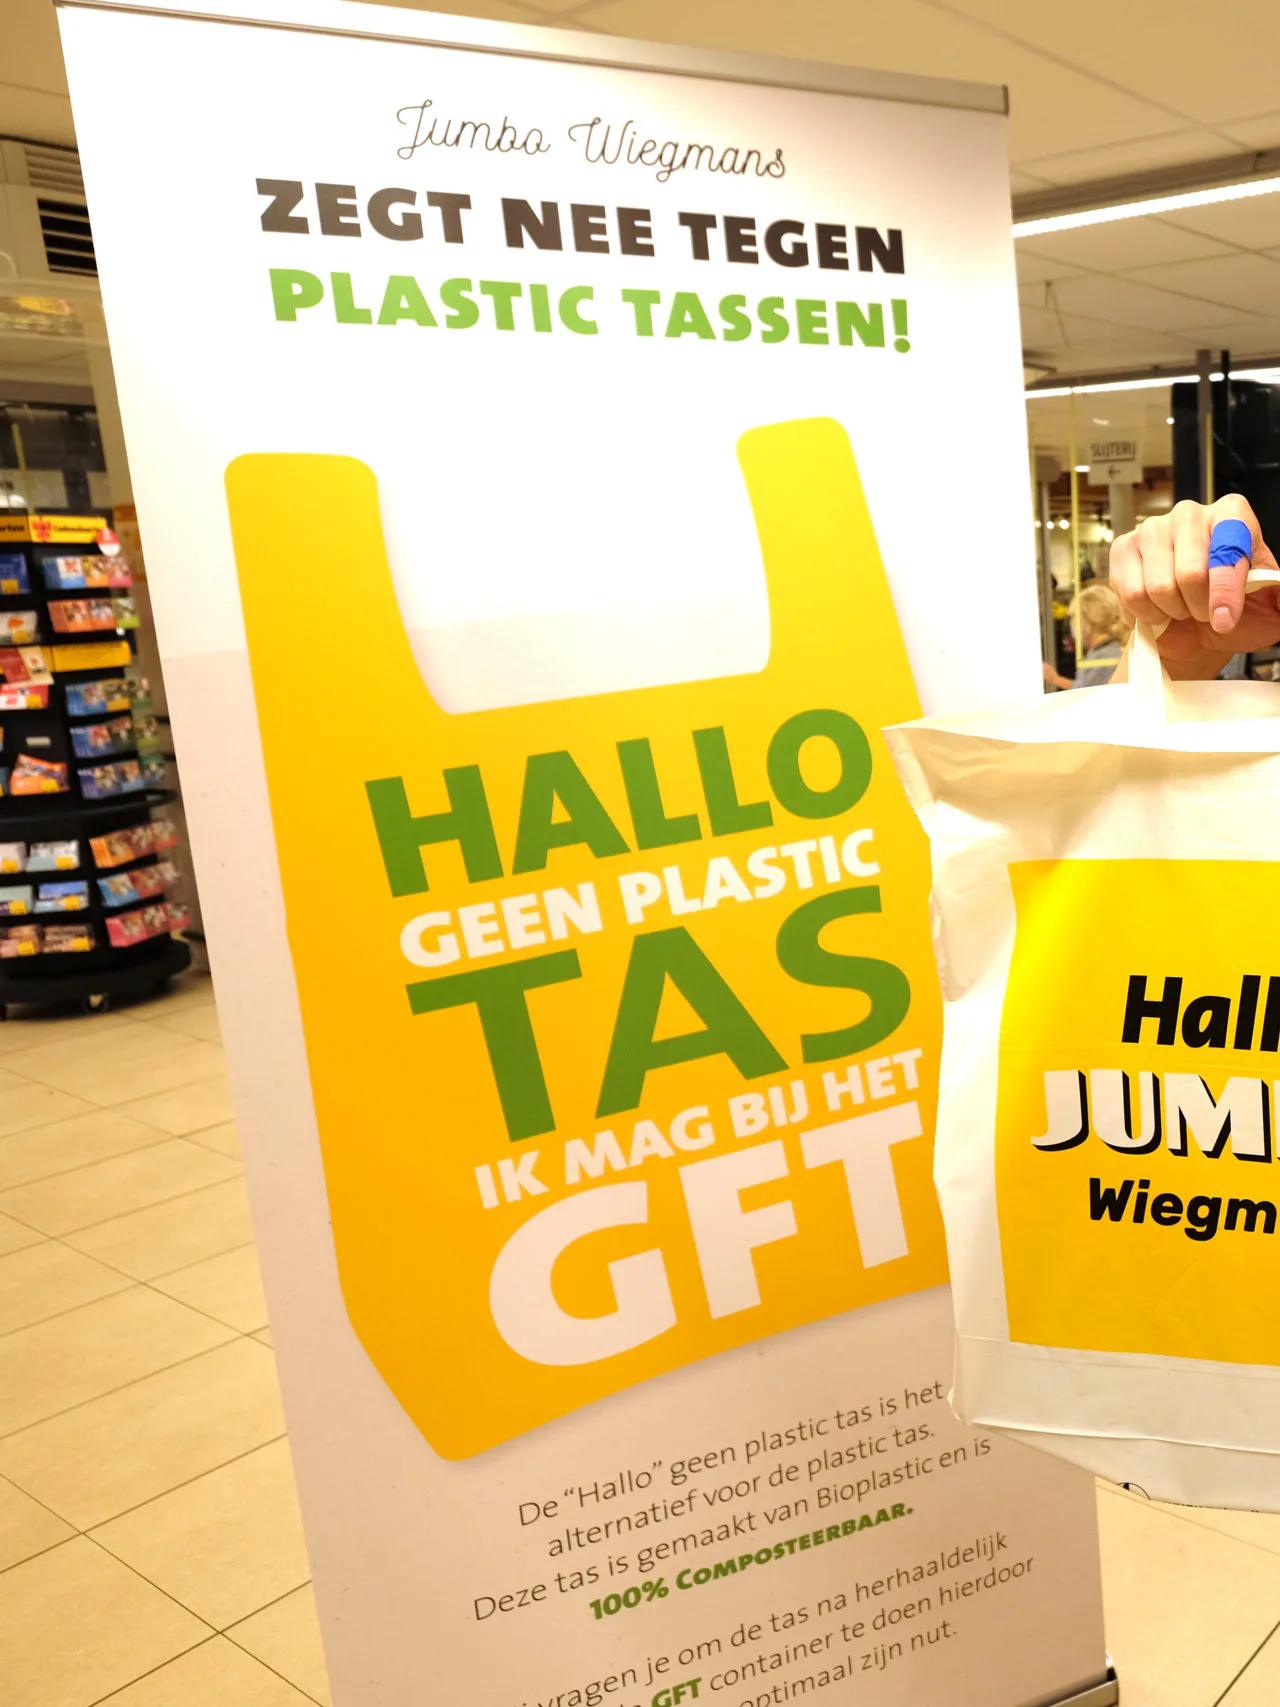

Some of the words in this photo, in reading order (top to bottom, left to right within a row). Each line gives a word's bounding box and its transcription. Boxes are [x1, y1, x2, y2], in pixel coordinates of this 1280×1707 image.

[396, 99, 551, 160] Jumbo
[568, 116, 788, 183] Wiegmans
[255, 178, 472, 244] ZEGT
[501, 197, 656, 257] NEE
[678, 211, 906, 275] TEGEN
[268, 268, 599, 336] PLASTIC
[621, 288, 911, 354] TASSEN!
[365, 708, 873, 898] HALLO
[400, 882, 604, 968] GEEN
[617, 828, 881, 925] PLASTIC
[406, 885, 912, 1143] TAS
[474, 1149, 550, 1210] IK
[564, 1105, 715, 1185] MAG
[728, 1080, 808, 1139] BIJ
[823, 1048, 924, 1112] HET
[488, 1100, 924, 1367] GFT
[518, 1498, 559, 1527] De
[669, 1445, 736, 1486] geen
[744, 1417, 829, 1464] plastic
[833, 1404, 873, 1430] tas
[879, 1396, 898, 1417] is
[904, 1380, 944, 1409] het
[548, 1488, 698, 1557] alternatief
[702, 1474, 761, 1507] voor
[767, 1462, 800, 1488] de
[807, 1435, 888, 1482] plastic
[891, 1422, 936, 1448] tas.
[473, 1582, 548, 1621] Deze
[553, 1564, 600, 1594] tas
[607, 1554, 630, 1577] is
[636, 1511, 758, 1574] gemaakt
[762, 1497, 810, 1526] van
[815, 1456, 935, 1510] Bioplastic
[938, 1446, 968, 1469] en
[973, 1437, 992, 1457] is
[588, 1576, 670, 1621] 100%
[644, 1656, 671, 1687] je
[677, 1637, 723, 1667] om
[729, 1623, 763, 1648] de
[768, 1605, 810, 1634] tas
[816, 1593, 848, 1617] na
[854, 1531, 1009, 1603] herhaaldelijk
[650, 1677, 703, 1707] GFT
[709, 1631, 835, 1692] container
[840, 1620, 867, 1643] te
[871, 1596, 933, 1632] doen
[938, 1556, 1036, 1606] hierdoor
[737, 1655, 855, 1707] optimaal
[860, 1640, 904, 1671] zijn
[909, 1620, 960, 1652] nut.
